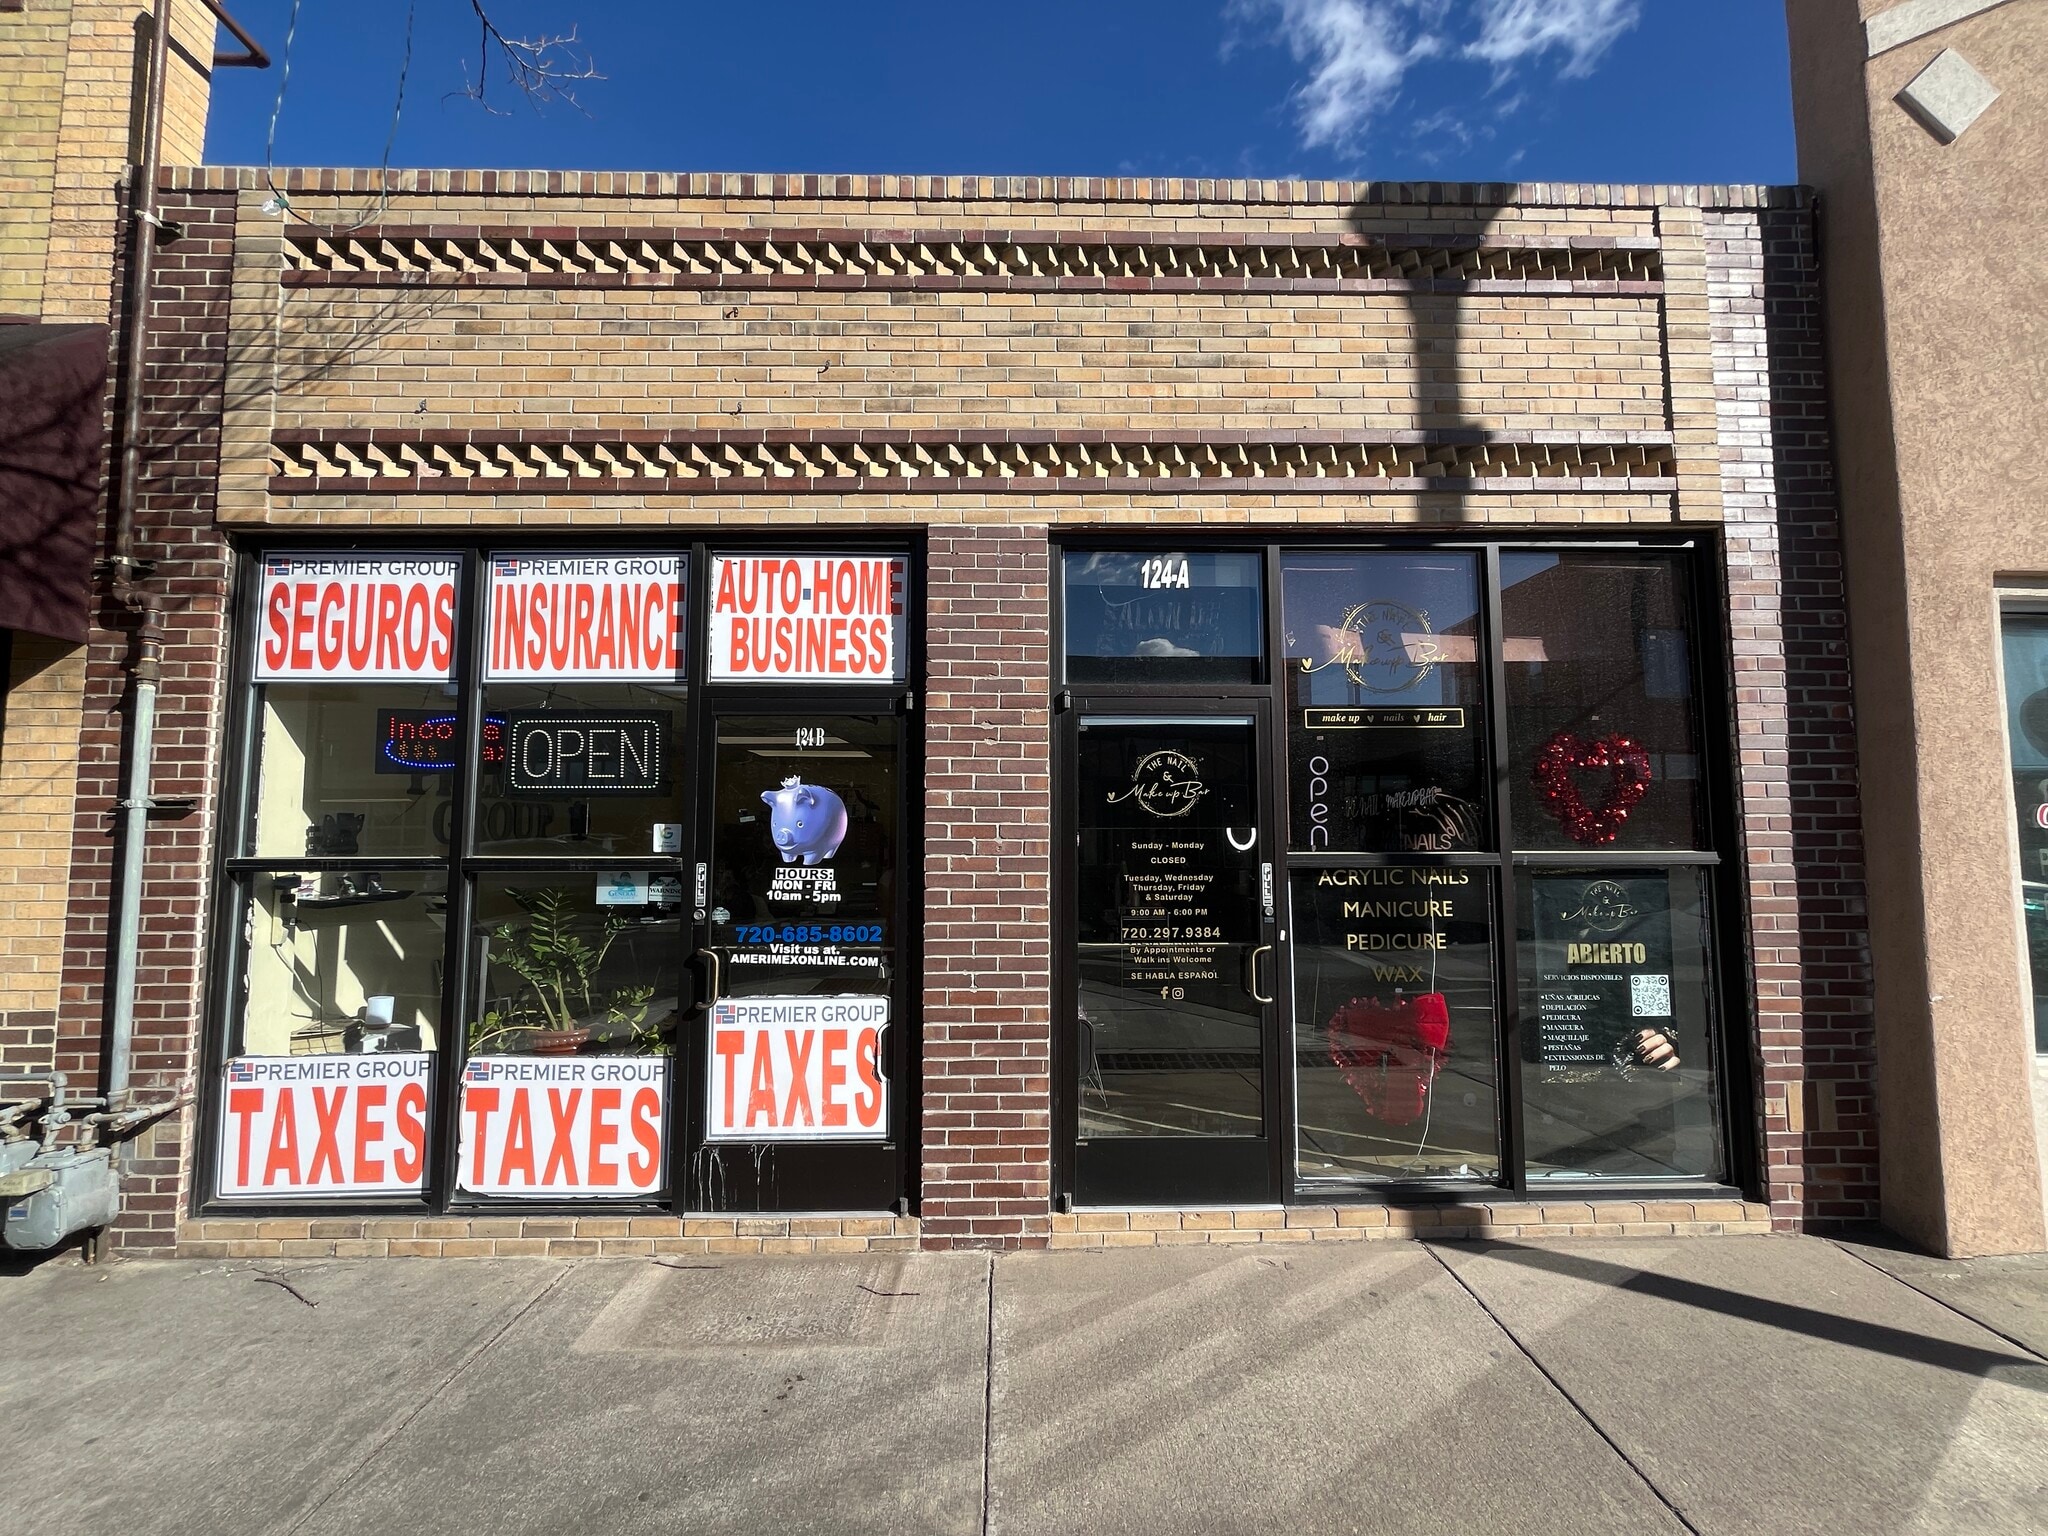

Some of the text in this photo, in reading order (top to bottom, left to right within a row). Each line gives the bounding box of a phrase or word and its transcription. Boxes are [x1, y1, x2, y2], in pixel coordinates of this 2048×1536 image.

[290, 560, 460, 576] PREMIER GROUP
[518, 560, 686, 576] PREMIER GROUP
[1141, 559, 1190, 589] 124-A
[265, 581, 456, 671] SEGUROS
[492, 582, 685, 671] INSURANCE
[730, 617, 887, 674] BUSINESS
[1322, 712, 1447, 724] make up nails hair
[389, 717, 499, 739] Incoe
[523, 729, 649, 778] OPEN
[1146, 756, 1187, 773] THE NAIL
[1162, 771, 1174, 783] &
[1170, 781, 1210, 799] Bar
[1131, 842, 1163, 850] Sunday
[1171, 842, 1205, 850] Monday
[1404, 833, 1452, 850] NAILS
[776, 869, 834, 880] HOURS:
[1124, 874, 1214, 883] Tuesday, Wednesday
[1318, 868, 1469, 886] ACRYLIC NAILS
[771, 880, 803, 890] MON
[815, 881, 836, 891] FRI
[1133, 884, 1206, 893] Thursday, Friday
[766, 890, 802, 901] 10am
[813, 891, 841, 903] 5pm
[1154, 894, 1193, 902] Saturday
[1195, 908, 1208, 916] PM
[1343, 901, 1454, 918] MANICURE
[735, 925, 883, 943] 720-685-8602
[1122, 927, 1221, 939] 720.297.9384
[1347, 933, 1447, 950] PEDICURE
[769, 944, 799, 955] Visit
[803, 946, 819, 955] us
[1130, 946, 1141, 955] By
[1143, 946, 1204, 955] Appointments
[1567, 943, 1646, 964] ABIERTO
[730, 955, 879, 967] AMERIMEXONLINE.COM
[1145, 972, 1176, 980] HABLA
[1178, 970, 1219, 979] ESPAÑOL
[1371, 965, 1424, 983] WAX
[1545, 993, 1564, 1001] UÑAS
[736, 1005, 885, 1023] PREMIER GROUP
[1547, 1034, 1590, 1042] MAQUILLAJE
[254, 1060, 432, 1081] PREMIER GROUP
[490, 1064, 667, 1081] PREMIER GROUP
[716, 1027, 882, 1127] TAXES
[229, 1082, 427, 1187] TAXES
[465, 1087, 661, 1188] TAXES
